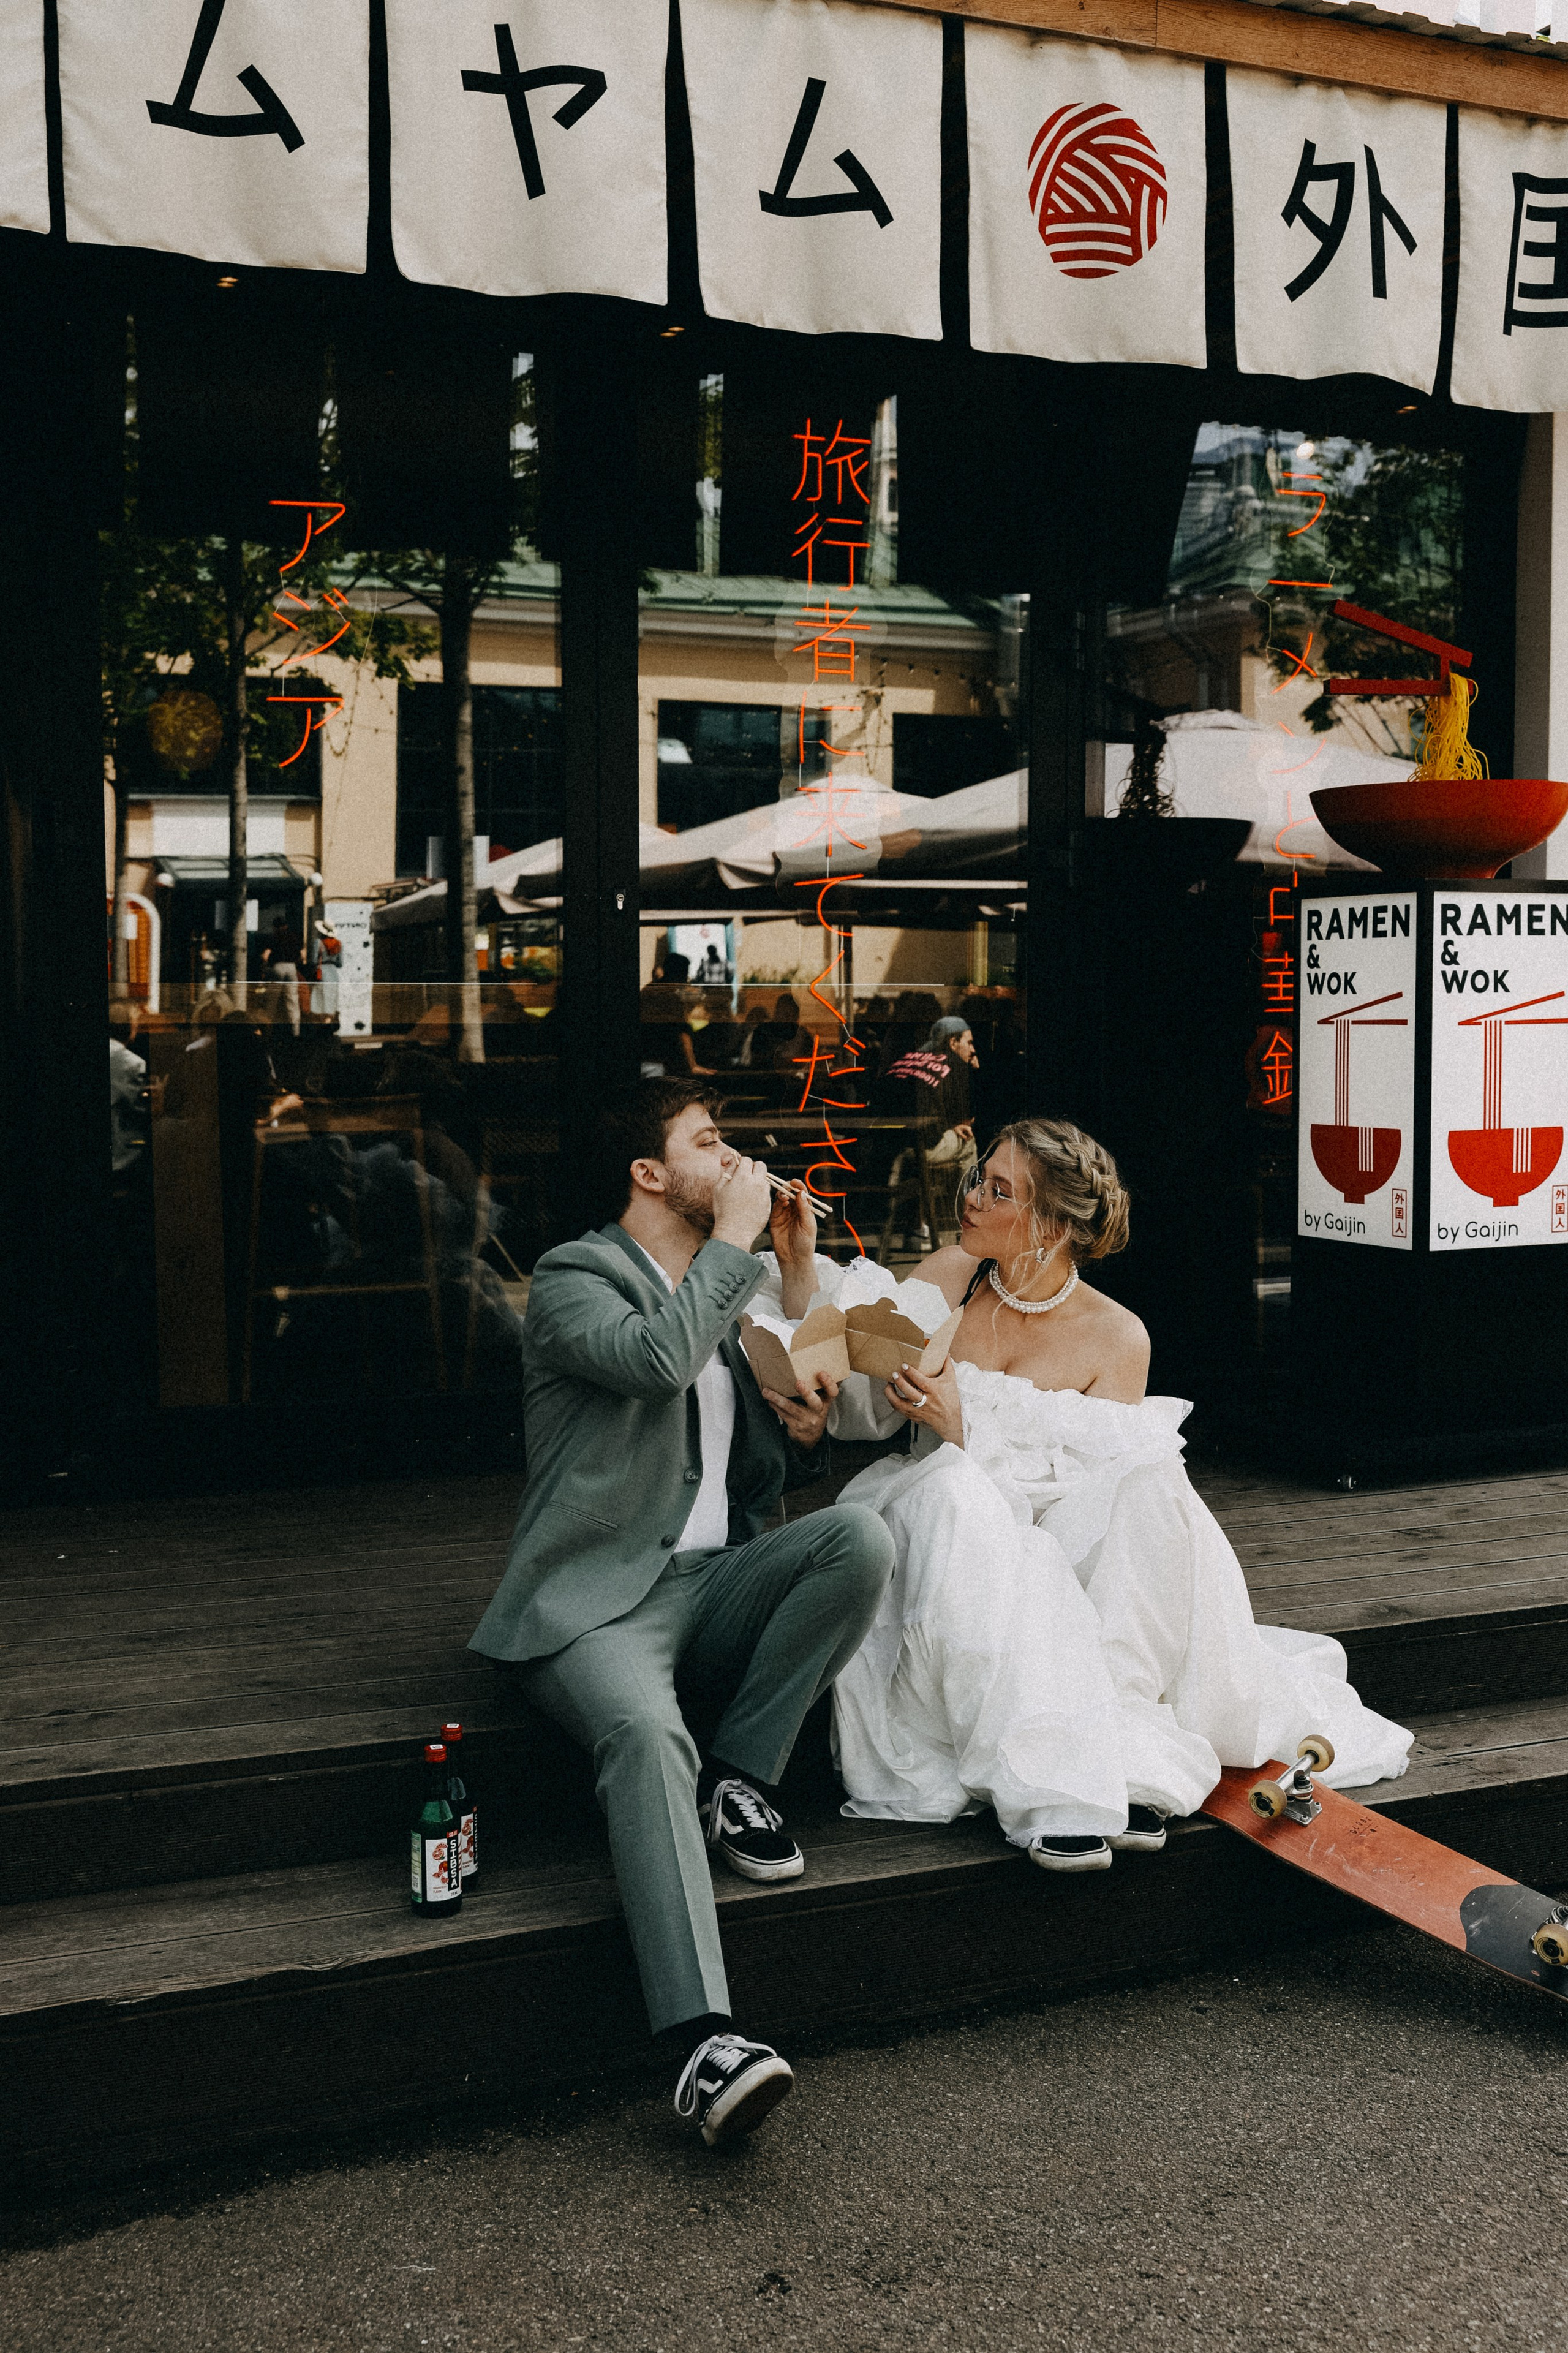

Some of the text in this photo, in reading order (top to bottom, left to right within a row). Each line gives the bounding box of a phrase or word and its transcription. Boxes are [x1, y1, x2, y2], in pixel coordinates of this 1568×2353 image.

[266, 500, 351, 768] アジア
[1306, 904, 1411, 941] RAMEN
[1441, 904, 1568, 936] RAMEN
[1306, 944, 1321, 969] &
[1441, 940, 1460, 966] &
[1306, 972, 1357, 995] WOK
[1441, 970, 1510, 994] WOK
[1304, 1210, 1366, 1237] by Gaijin
[1438, 1221, 1518, 1244] by Gaijin
[1349, 1816, 1373, 1834] GLOBE
